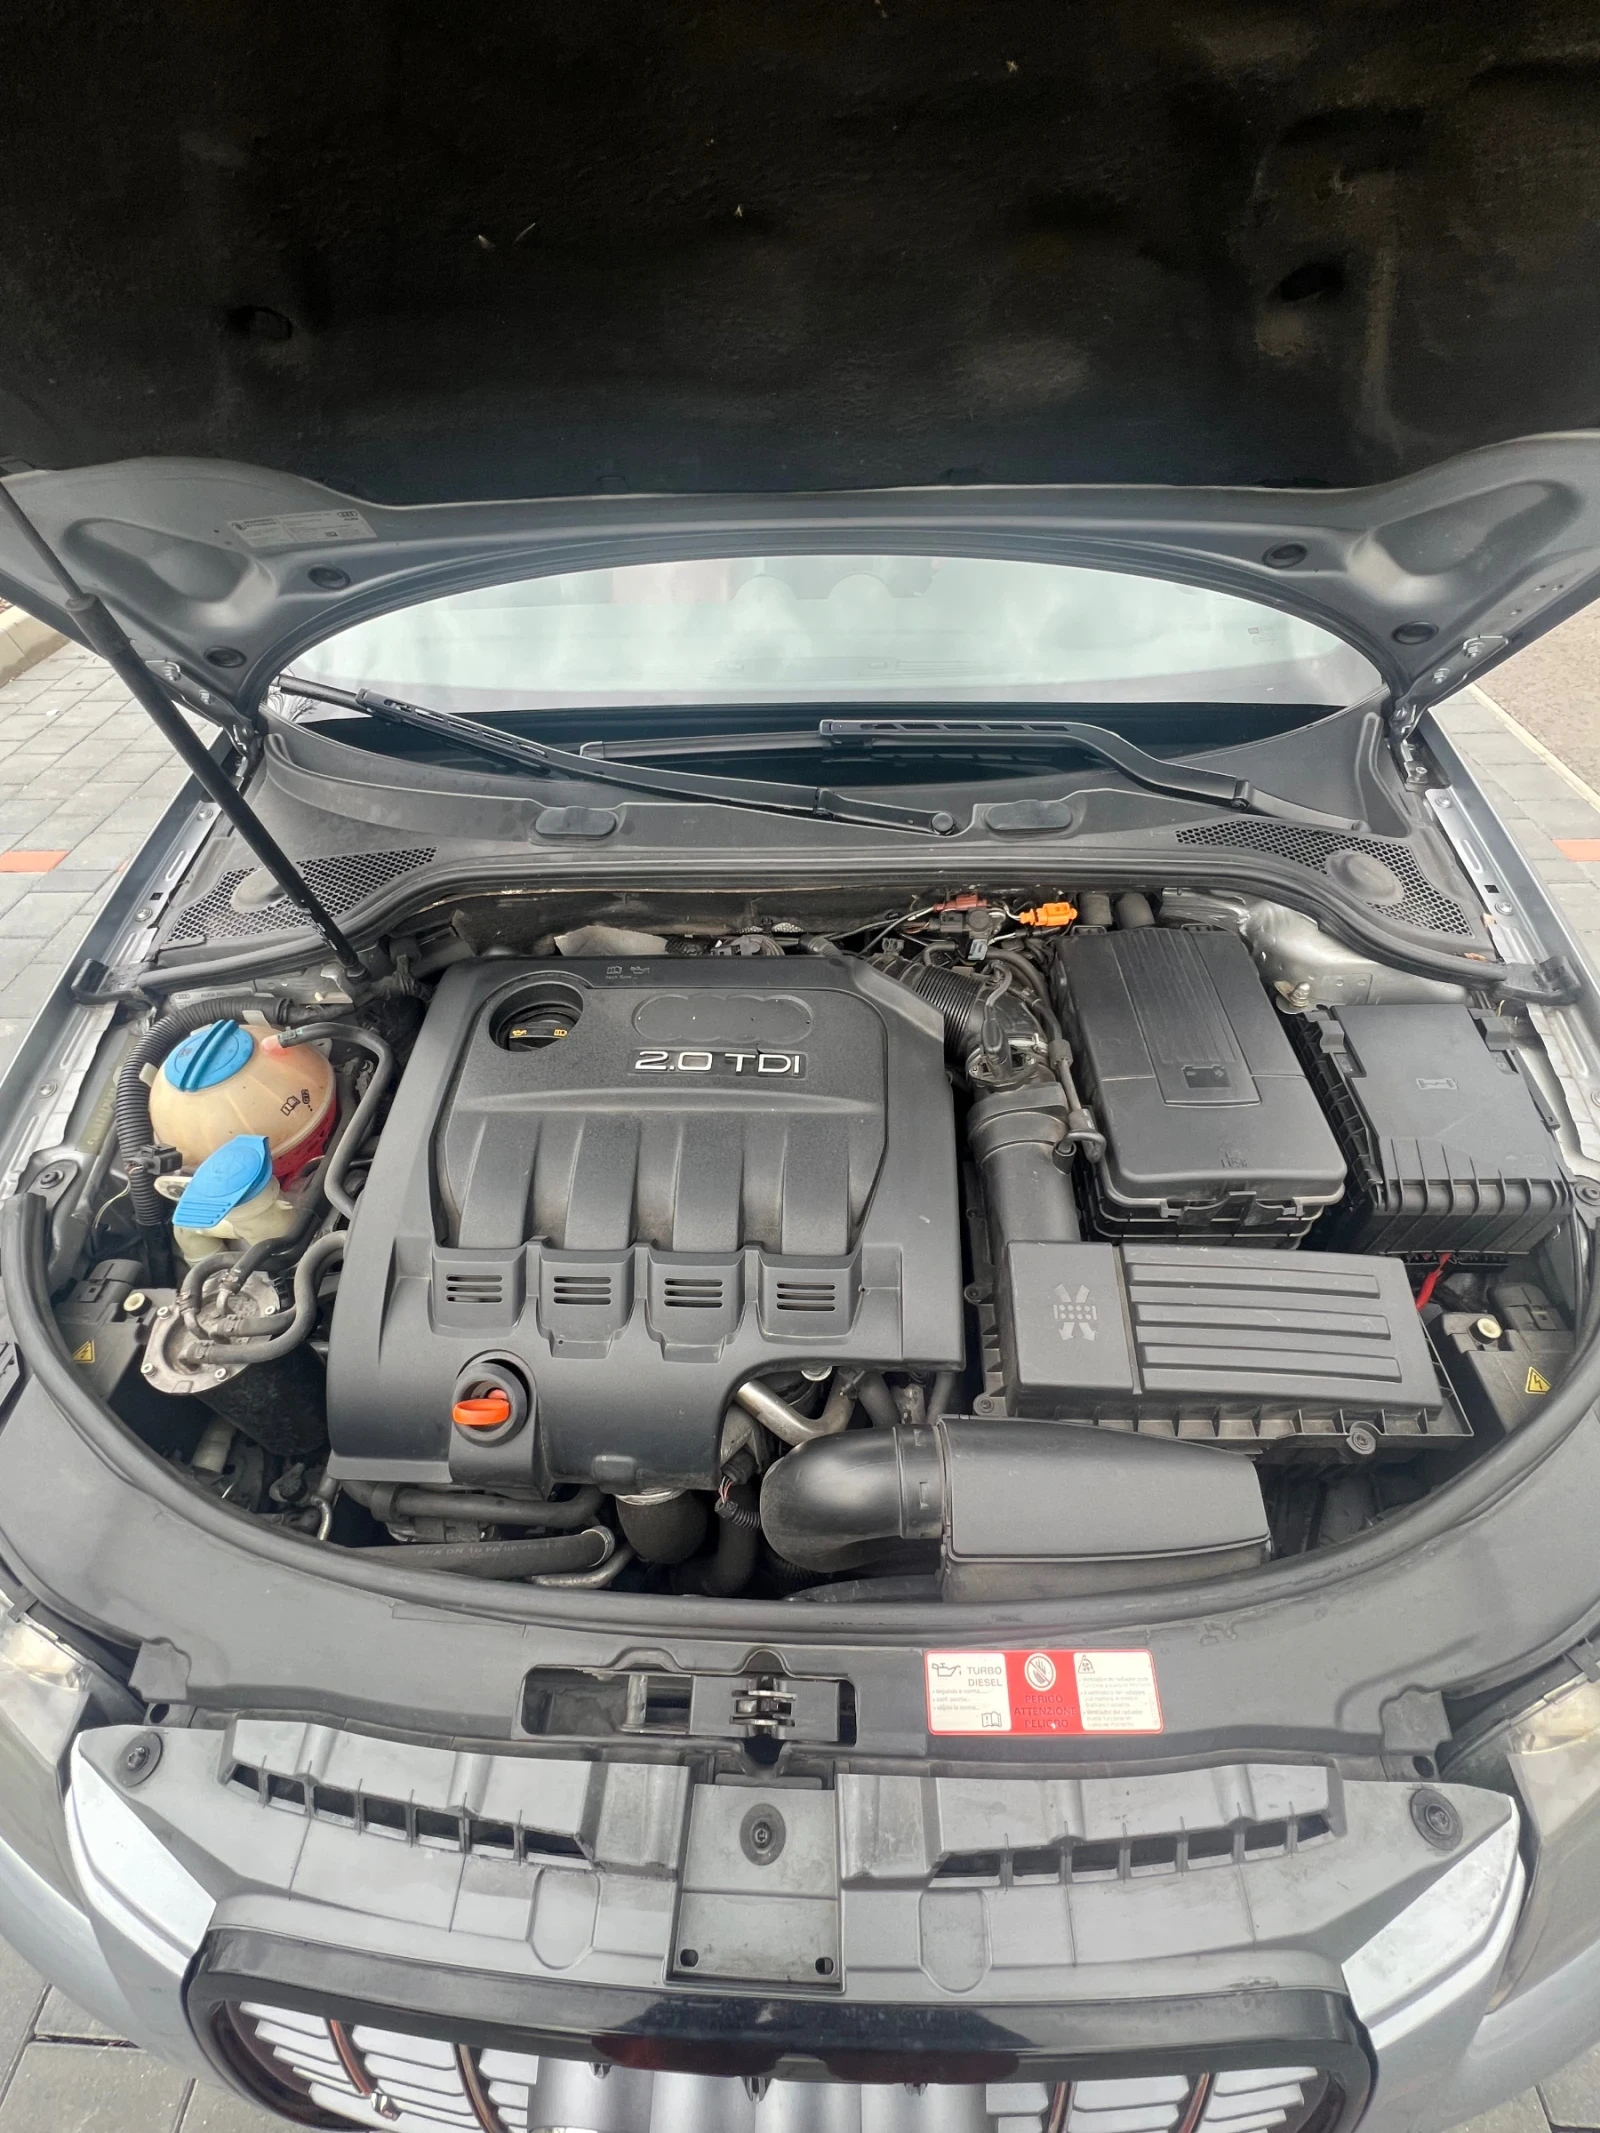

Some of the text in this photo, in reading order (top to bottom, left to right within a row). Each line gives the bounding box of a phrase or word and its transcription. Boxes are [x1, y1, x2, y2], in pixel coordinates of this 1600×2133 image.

[634, 1051, 800, 1074] 2.0 TDI
[967, 1666, 1002, 1675] TURBO
[968, 1678, 1003, 1687] DIESEL
[1025, 1695, 1063, 1703] PERIGO
[1014, 1707, 1077, 1716] ATTENZIONE
[1025, 1719, 1069, 1728] PELIGRO
